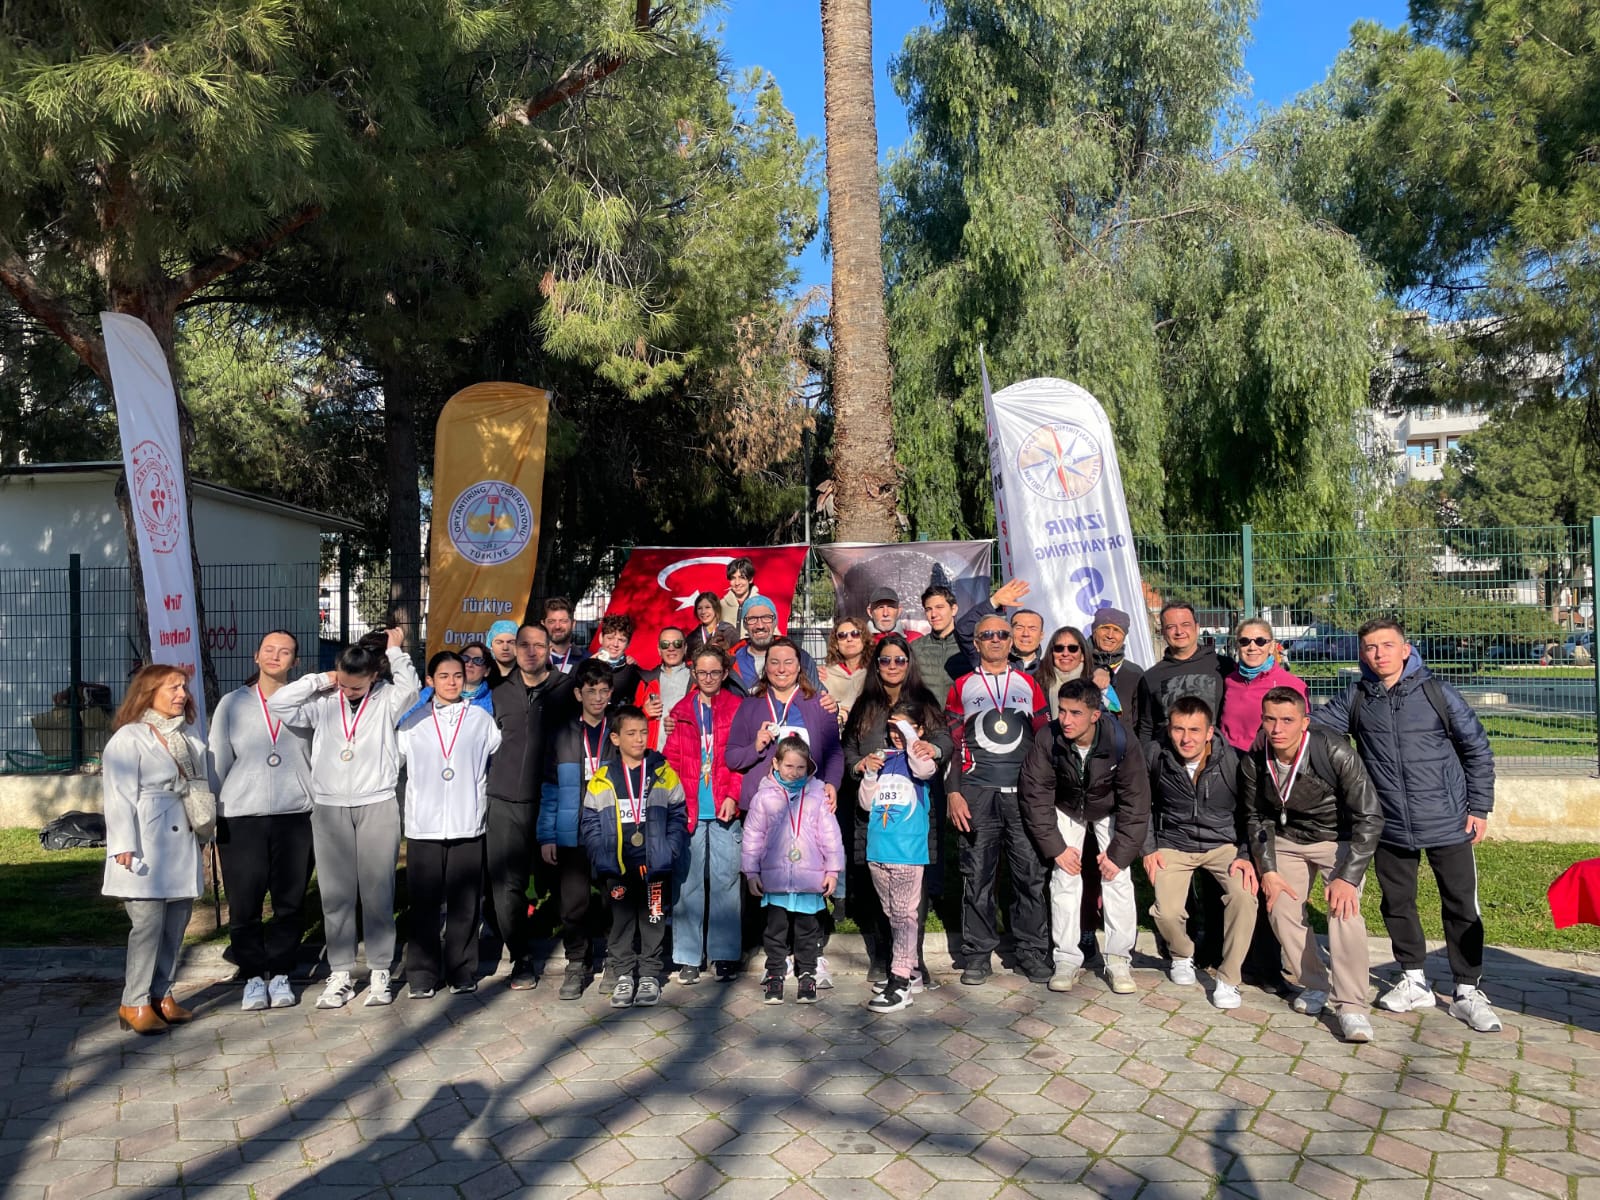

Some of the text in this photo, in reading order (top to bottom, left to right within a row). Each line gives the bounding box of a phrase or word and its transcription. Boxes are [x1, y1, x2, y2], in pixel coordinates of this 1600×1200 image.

[500, 486, 528, 537] FEDERASYONU
[462, 596, 513, 615] Türkiye
[444, 629, 489, 646] Oryan
[619, 808, 647, 819] 065
